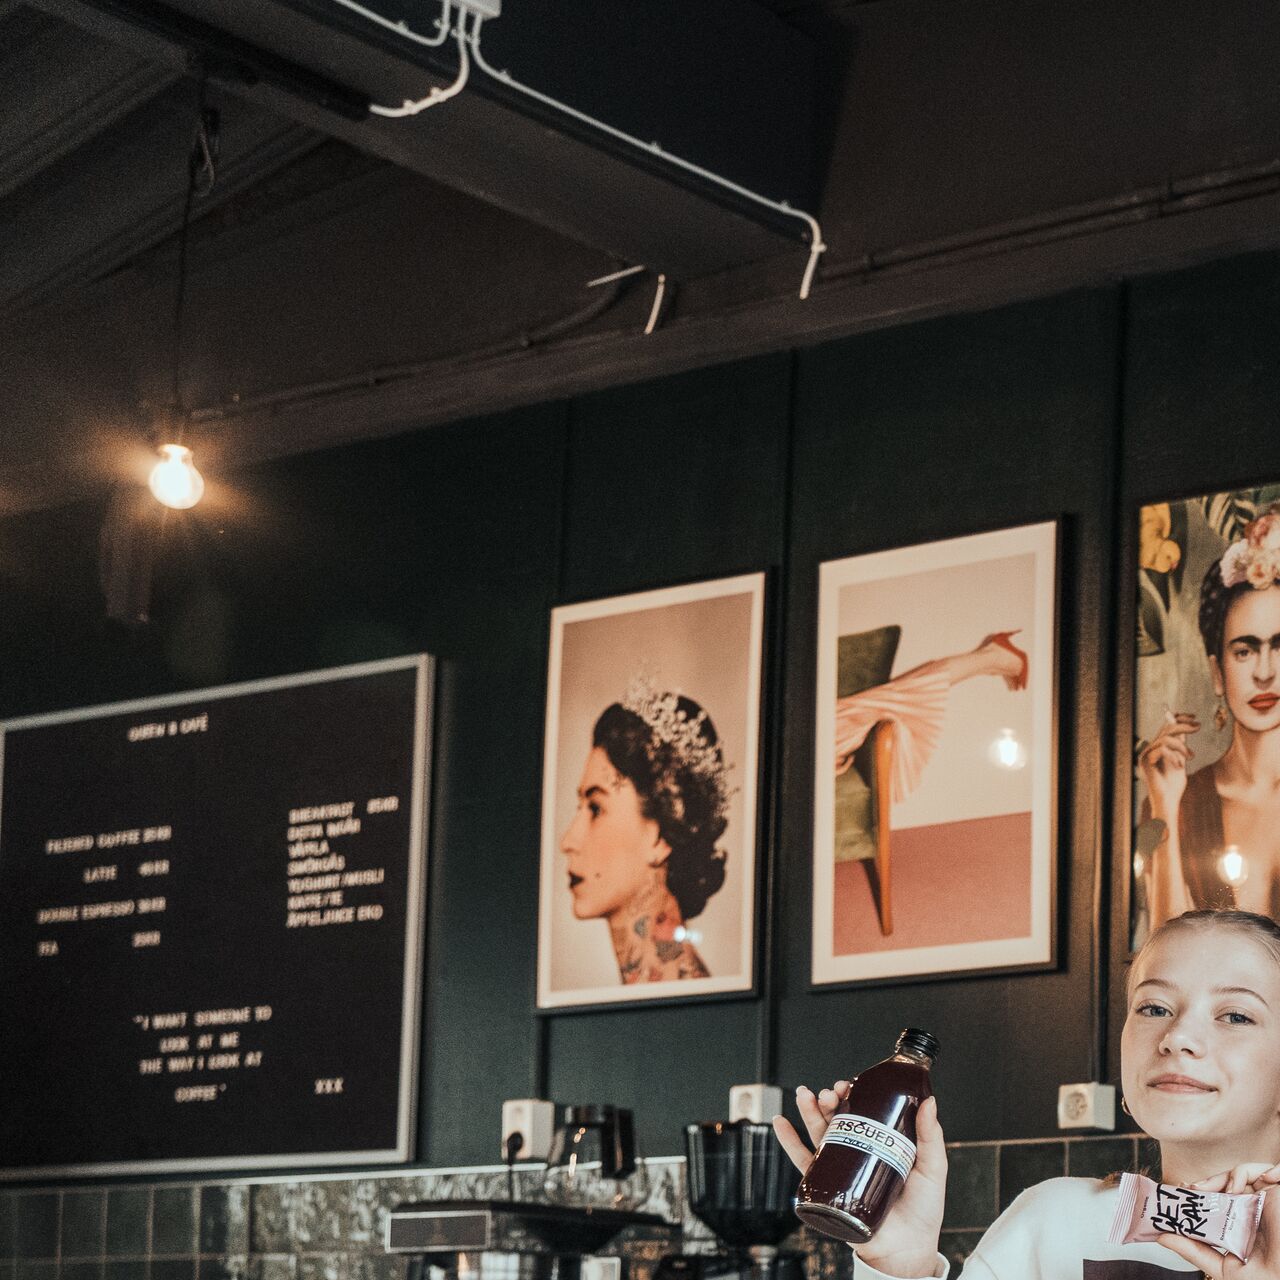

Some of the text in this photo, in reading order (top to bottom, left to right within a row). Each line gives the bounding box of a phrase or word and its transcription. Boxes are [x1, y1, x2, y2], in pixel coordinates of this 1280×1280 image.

[289, 802, 354, 823] BREAKFAST
[98, 830, 139, 847] COFFEE
[39, 908, 77, 922] DOUBLE
[82, 901, 134, 918] ESPRESSO
[38, 941, 58, 955] TEA
[153, 1013, 186, 1028] WANT
[195, 1007, 249, 1026] SOMEONE
[255, 1006, 272, 1020] TO
[161, 1033, 238, 1052] LOOK AT ME
[141, 1052, 261, 1073] THE WAY I LOOK AT
[1150, 1183, 1181, 1234] GET
